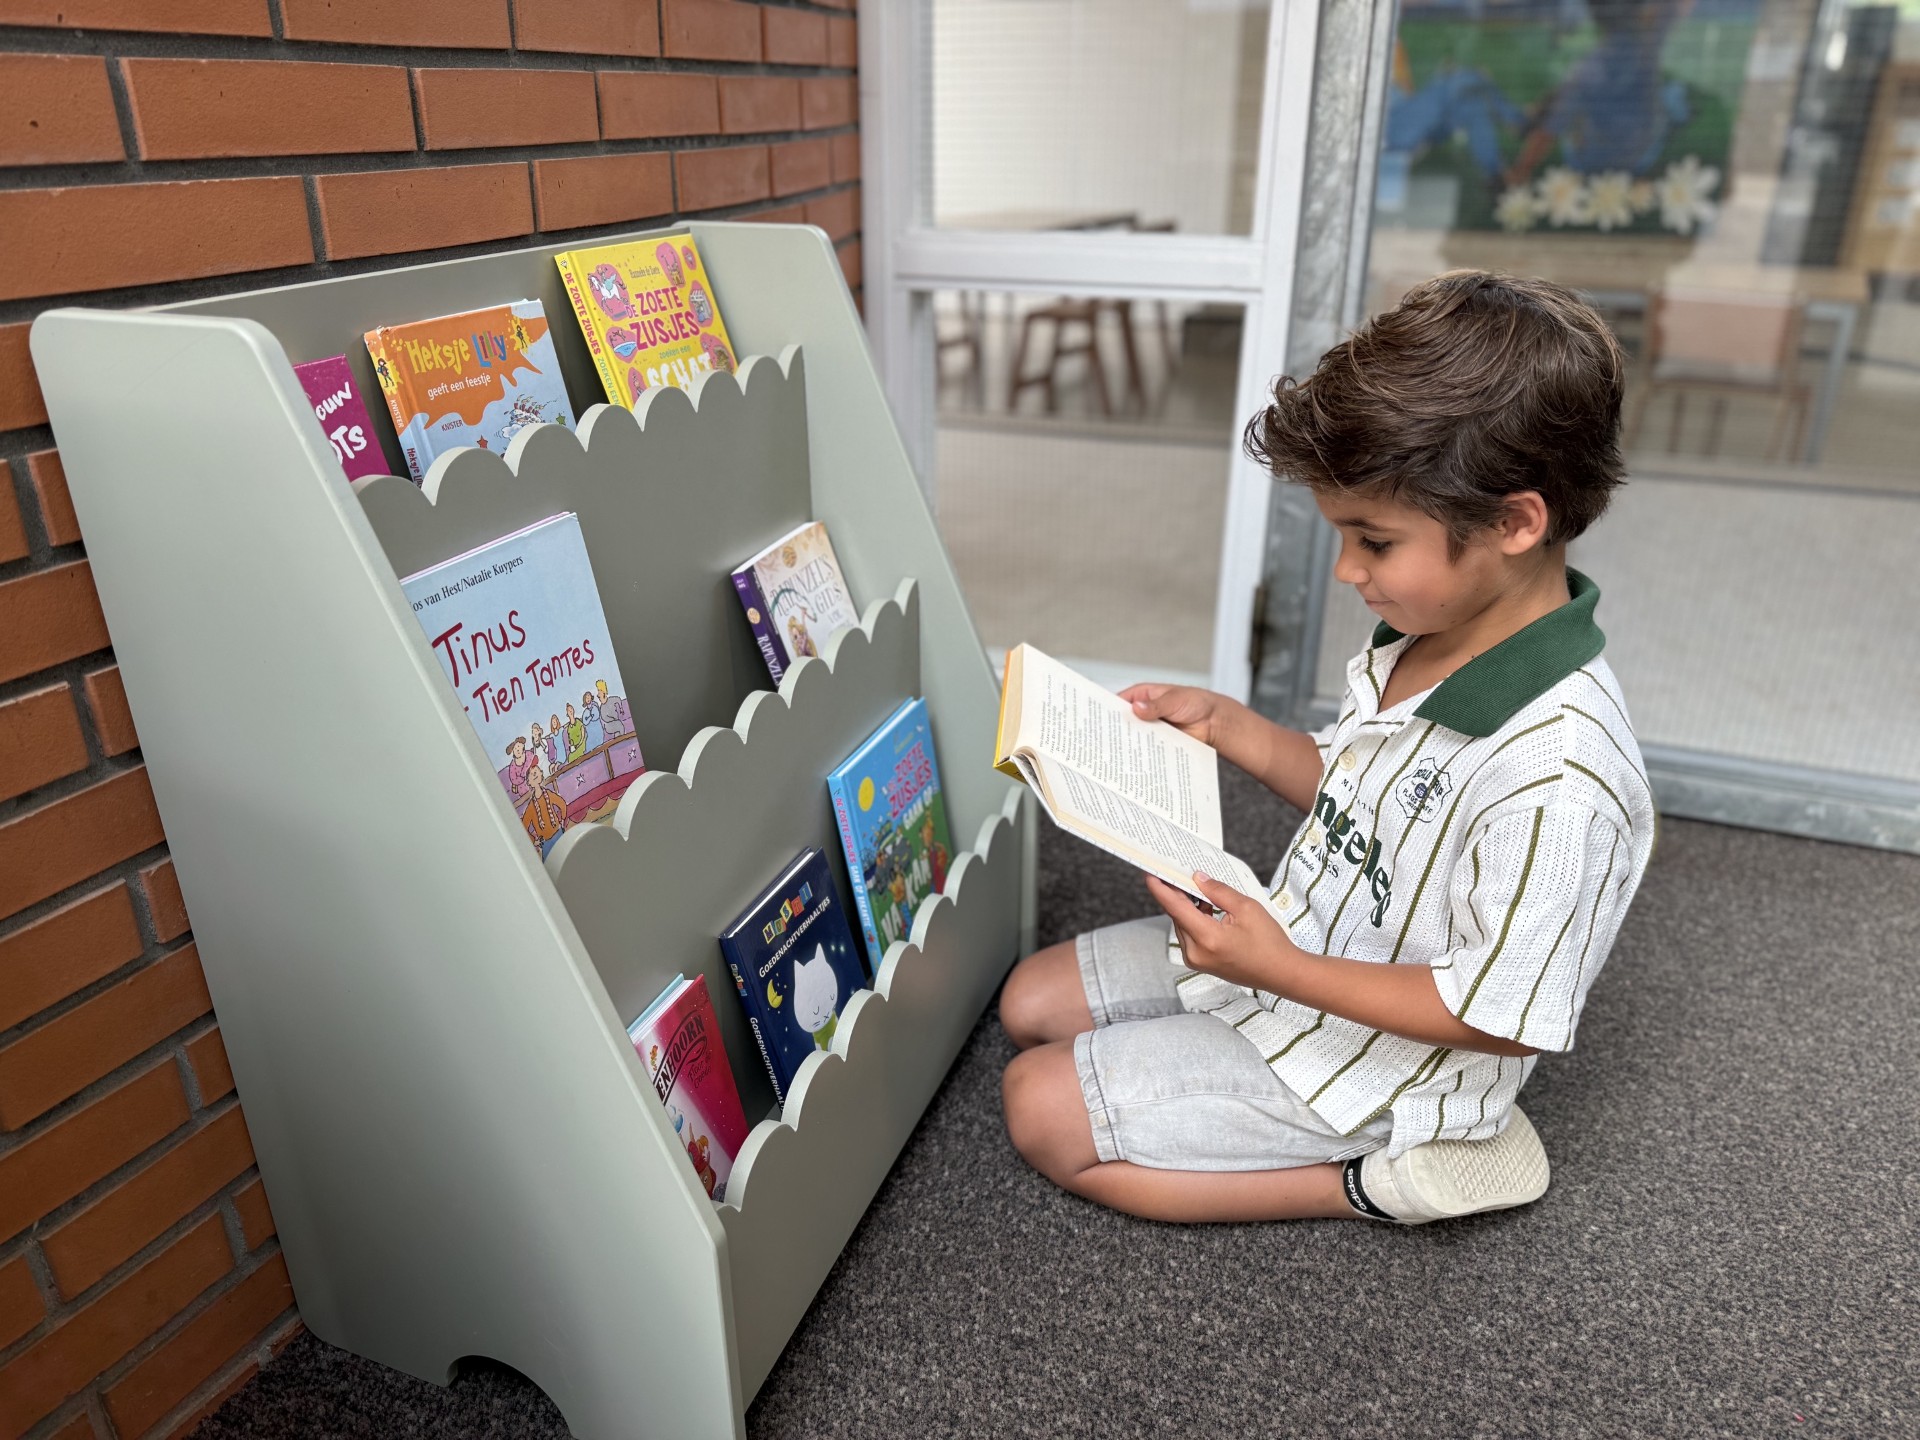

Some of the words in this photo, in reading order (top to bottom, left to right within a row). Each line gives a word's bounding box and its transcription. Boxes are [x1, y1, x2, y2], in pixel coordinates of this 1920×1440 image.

[625, 304, 639, 319] DE
[635, 286, 683, 316] ZOETE
[564, 272, 575, 285] DE
[570, 286, 586, 318] ZOETE
[582, 318, 602, 355] ZUSJES
[597, 357, 614, 390] ZOEKEN
[629, 311, 701, 350] ZUSJES
[405, 337, 471, 375] Heksje
[472, 330, 508, 369] Lilly
[315, 381, 352, 421] ouw
[427, 383, 449, 400] geeft
[450, 381, 465, 392] een
[465, 373, 492, 388] feestje
[389, 399, 405, 428] KNISTER
[441, 419, 464, 432] KNISTER
[406, 447, 420, 474] Heksje
[409, 600, 424, 612] os
[424, 593, 442, 608] van
[492, 555, 525, 577] Kuypers
[431, 609, 527, 688] Tinus
[472, 681, 525, 723] Tien
[525, 639, 595, 697] Tantes
[889, 759, 932, 819] ZUSJES
[838, 809, 850, 832] ZOETE
[843, 834, 857, 864] ZUSJES
[1292, 844, 1315, 872] lifornia
[1314, 791, 1392, 928] ngeles
[655, 1014, 705, 1098] ENHOORN
[750, 1016, 785, 1111] GOEDENACHTVERHAAL
[1347, 1168, 1367, 1210] adidas
